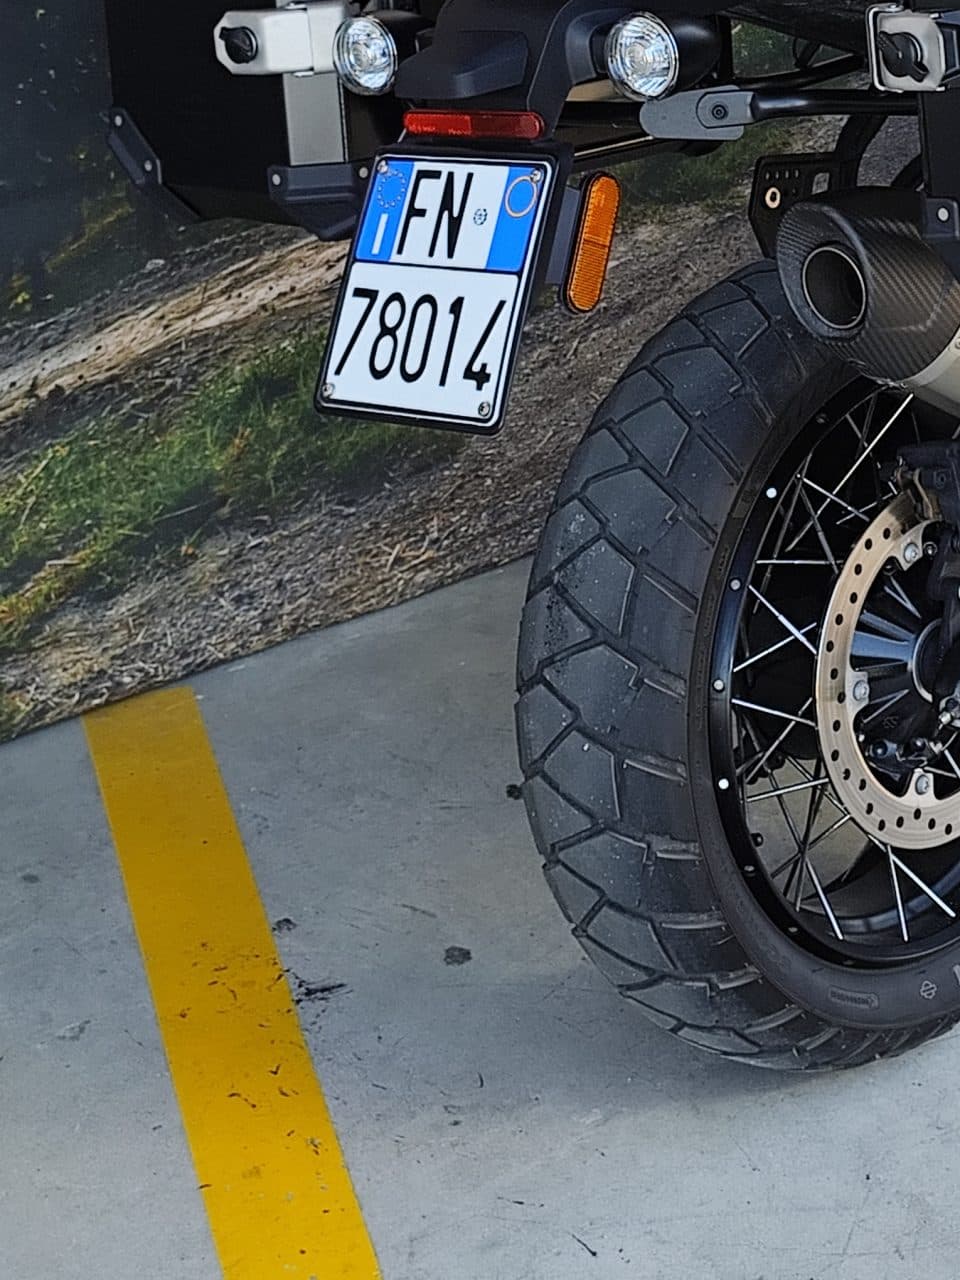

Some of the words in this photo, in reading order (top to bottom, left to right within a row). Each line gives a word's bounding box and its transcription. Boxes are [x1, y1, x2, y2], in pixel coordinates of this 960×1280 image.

[371, 212, 389, 256] I
[396, 169, 475, 260] FN
[333, 287, 508, 392] 78014
